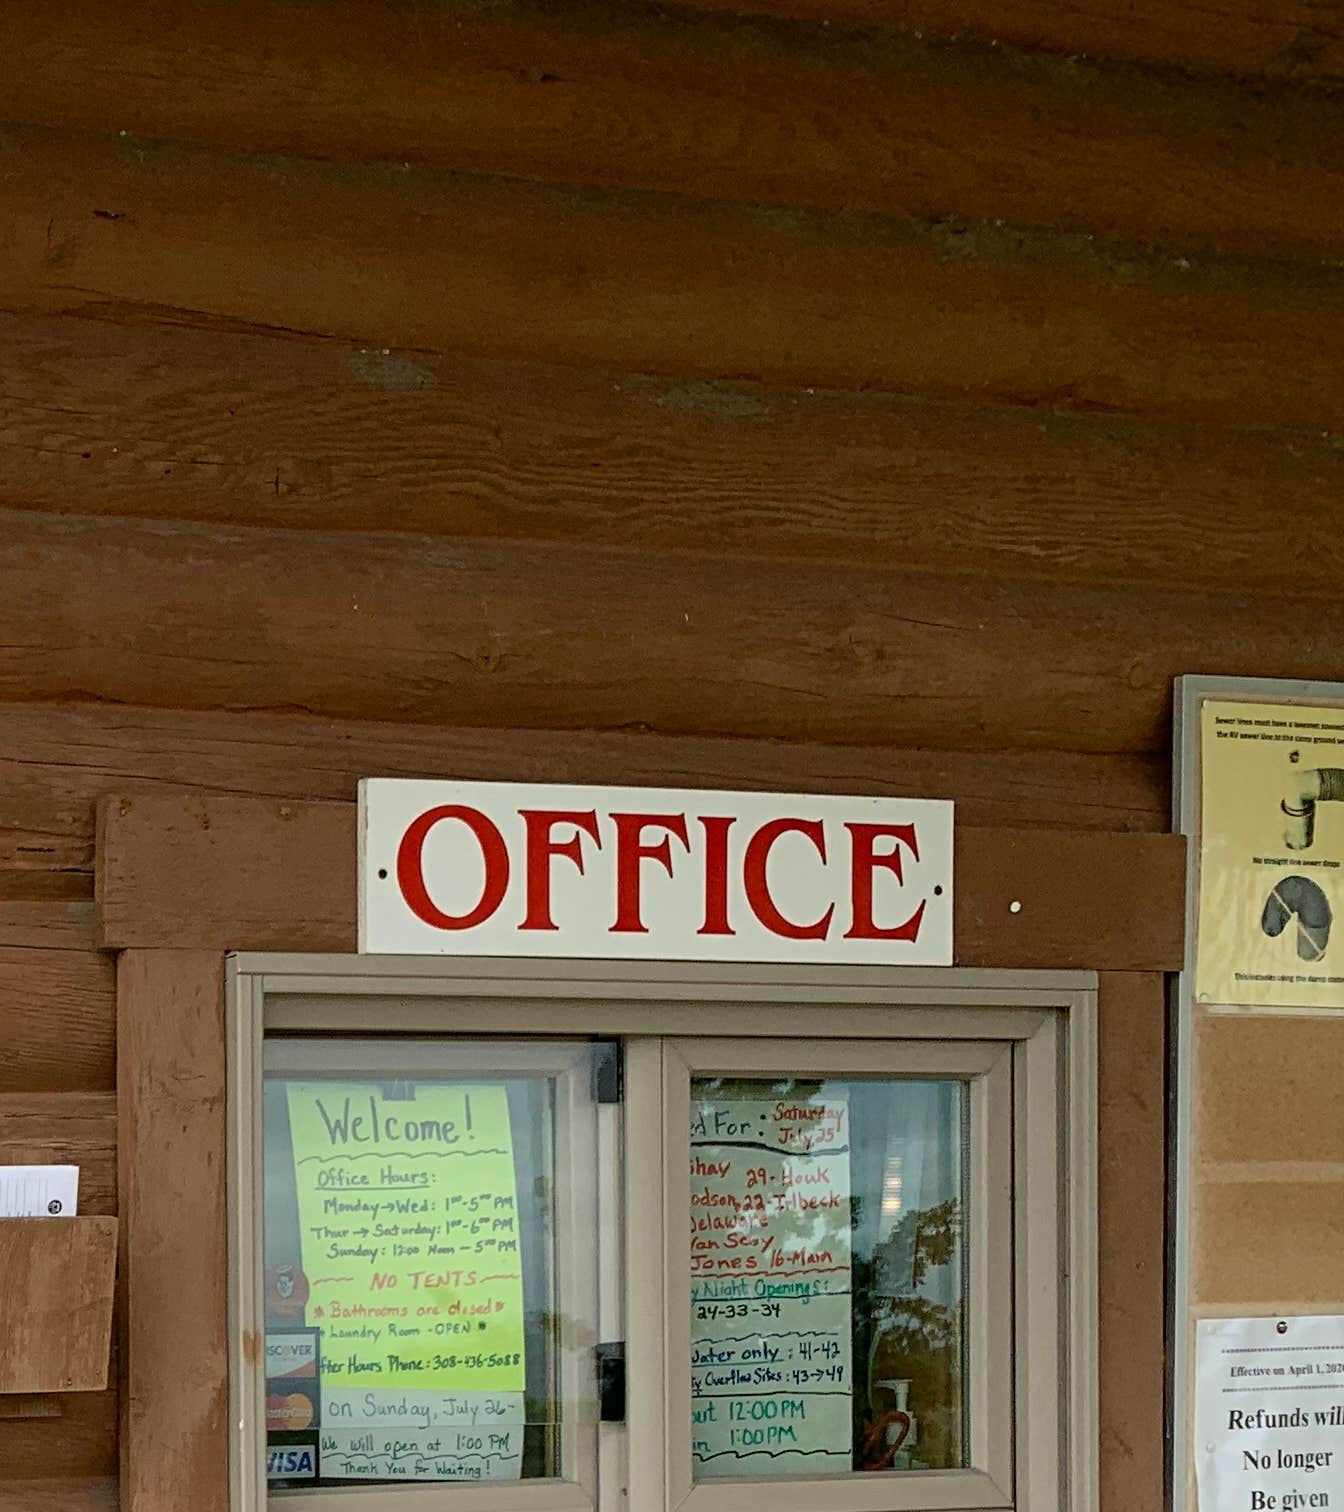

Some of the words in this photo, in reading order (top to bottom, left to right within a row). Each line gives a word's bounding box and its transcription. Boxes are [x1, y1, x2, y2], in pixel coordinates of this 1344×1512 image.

[397, 804, 926, 942] OFFICE
[315, 1094, 475, 1145] Welcome!
[318, 1167, 370, 1186] Office
[381, 1165, 436, 1184] Hours:
[408, 1271, 478, 1289] TENTS
[330, 1300, 408, 1319] Bathrooms
[1230, 1364, 1271, 1378] Effective
[1288, 1363, 1313, 1377] April
[1228, 1407, 1309, 1430] Refunds
[1243, 1450, 1271, 1471] No
[1277, 1448, 1333, 1473] longer
[1251, 1491, 1276, 1511] Be
